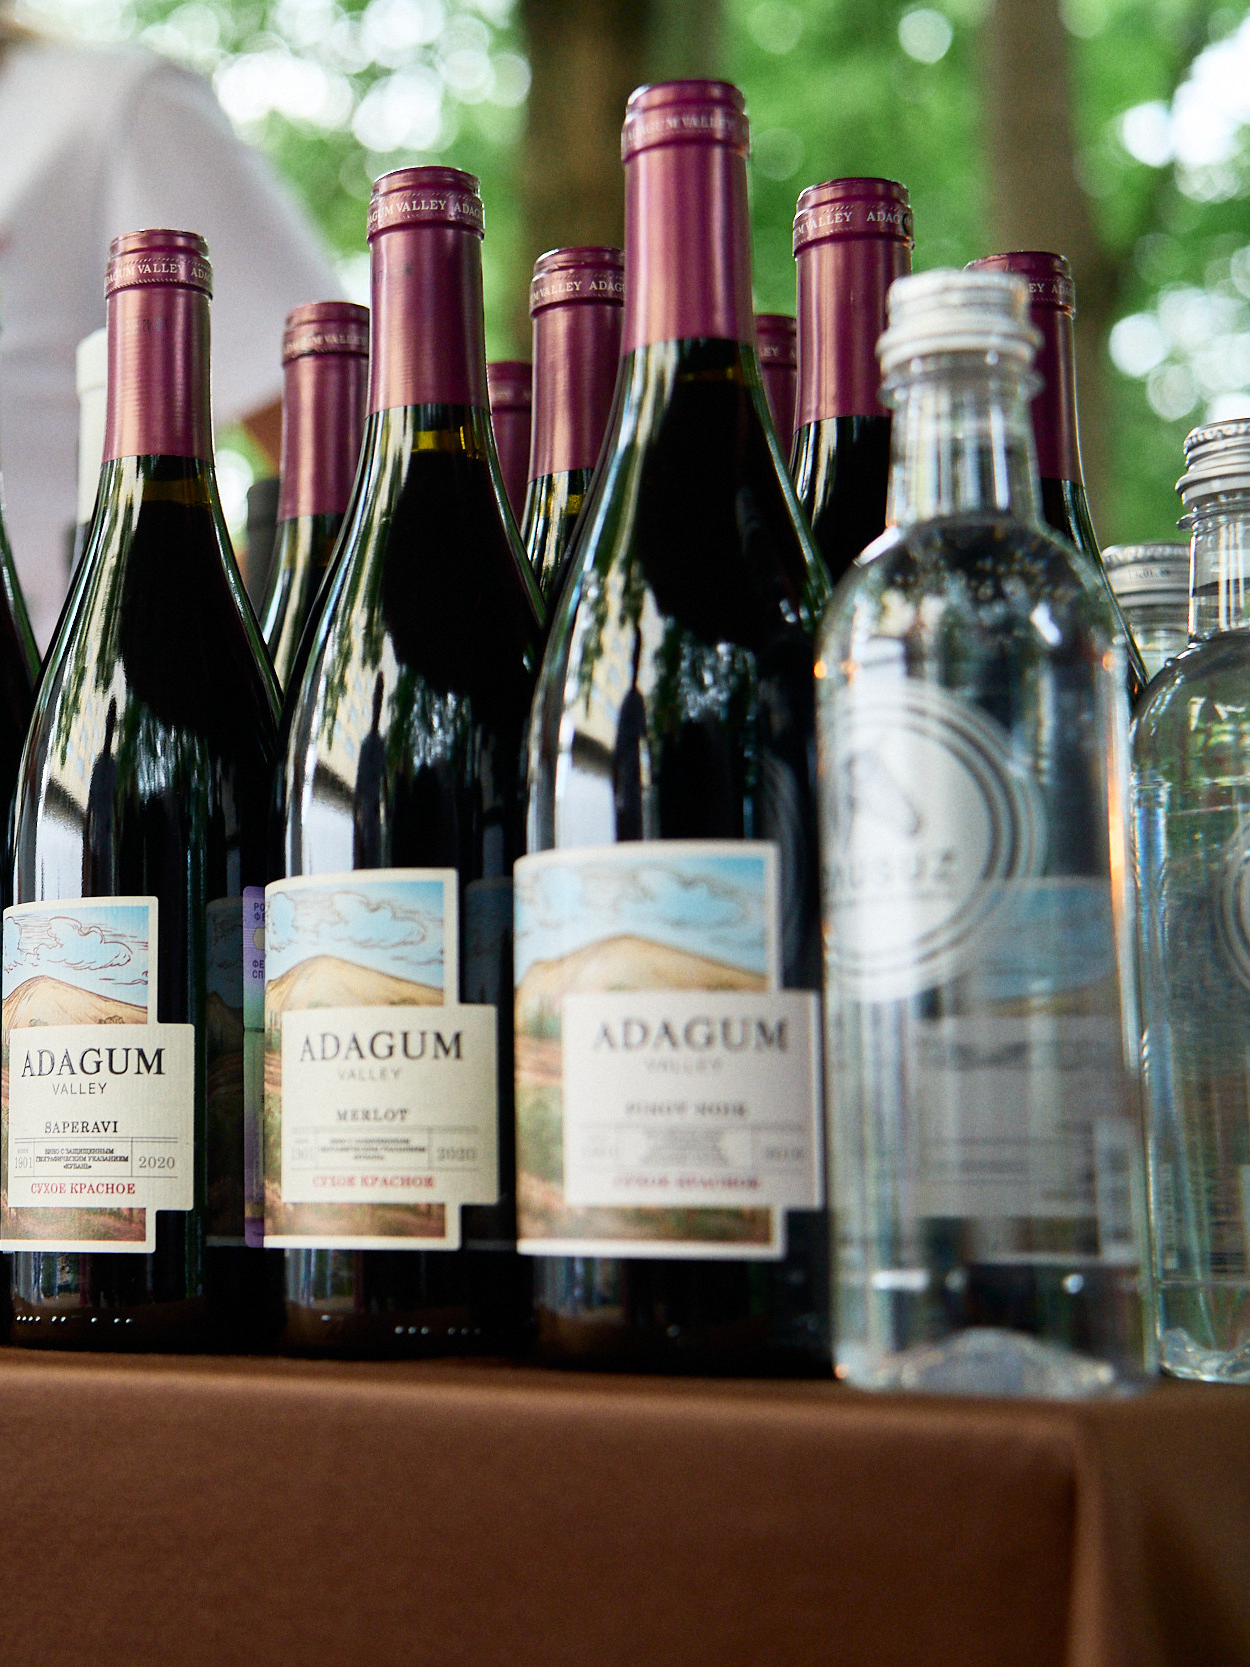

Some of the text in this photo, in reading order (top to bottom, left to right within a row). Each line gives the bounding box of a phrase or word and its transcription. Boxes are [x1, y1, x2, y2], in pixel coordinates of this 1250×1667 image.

[396, 200, 447, 213] VALLEY
[806, 211, 853, 230] VALLEY
[137, 263, 185, 274] VALLEY
[540, 281, 582, 297] VALLEY
[593, 1015, 789, 1051] ADAGUM
[299, 1030, 463, 1062] ADAGUM
[21, 1047, 166, 1078] ADAGUM
[338, 1067, 402, 1082] VALLEY
[52, 1082, 107, 1096] VALLEY
[336, 1108, 408, 1122] MERLOT
[44, 1120, 119, 1134] SAPERAVI
[14, 1156, 33, 1169] 1901
[138, 1156, 175, 1169] 2020
[31, 1182, 136, 1195] СУХОЕ КРАСНОЕ
